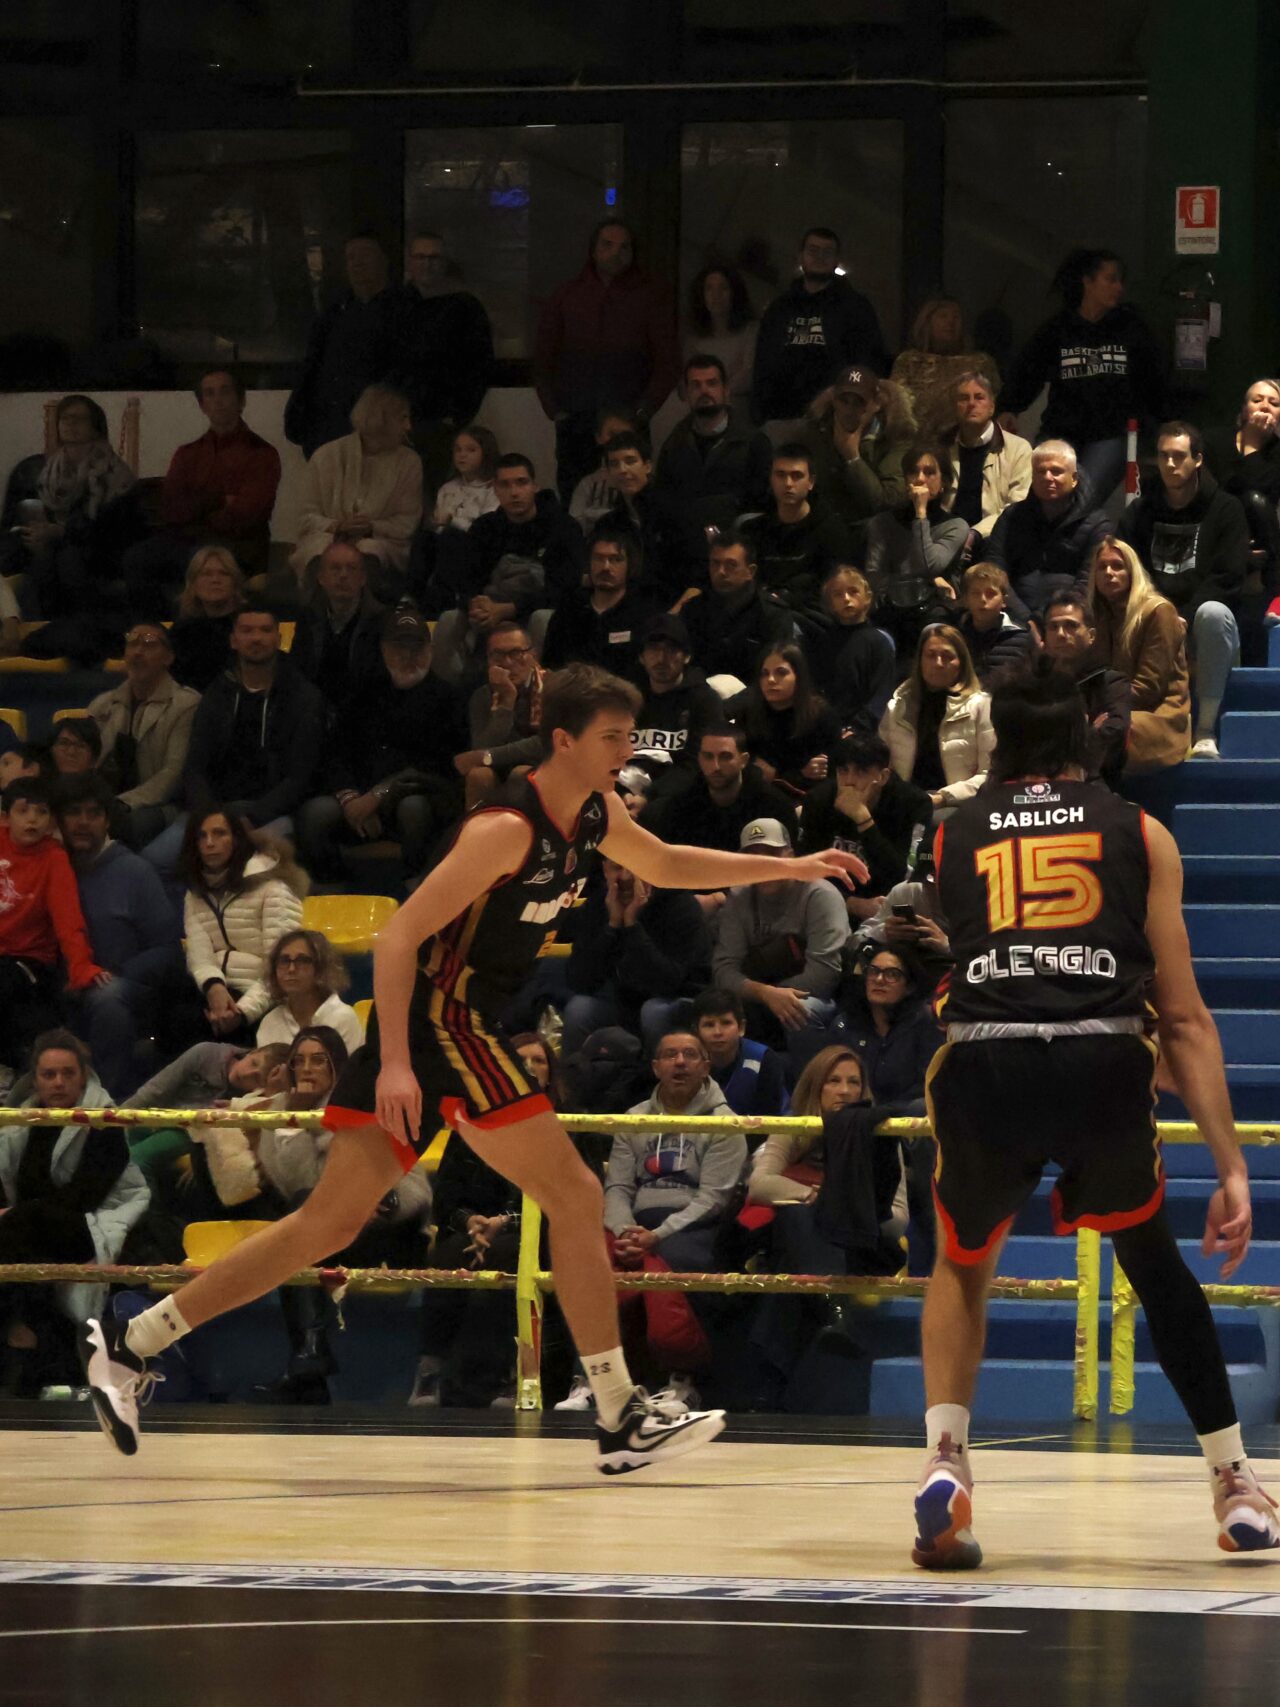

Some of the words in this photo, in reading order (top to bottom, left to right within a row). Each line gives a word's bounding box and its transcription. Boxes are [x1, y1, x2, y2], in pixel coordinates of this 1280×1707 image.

[989, 806, 1084, 831] SABLICH
[974, 832, 1104, 934] 15
[966, 944, 1117, 984] OLEGGIO
